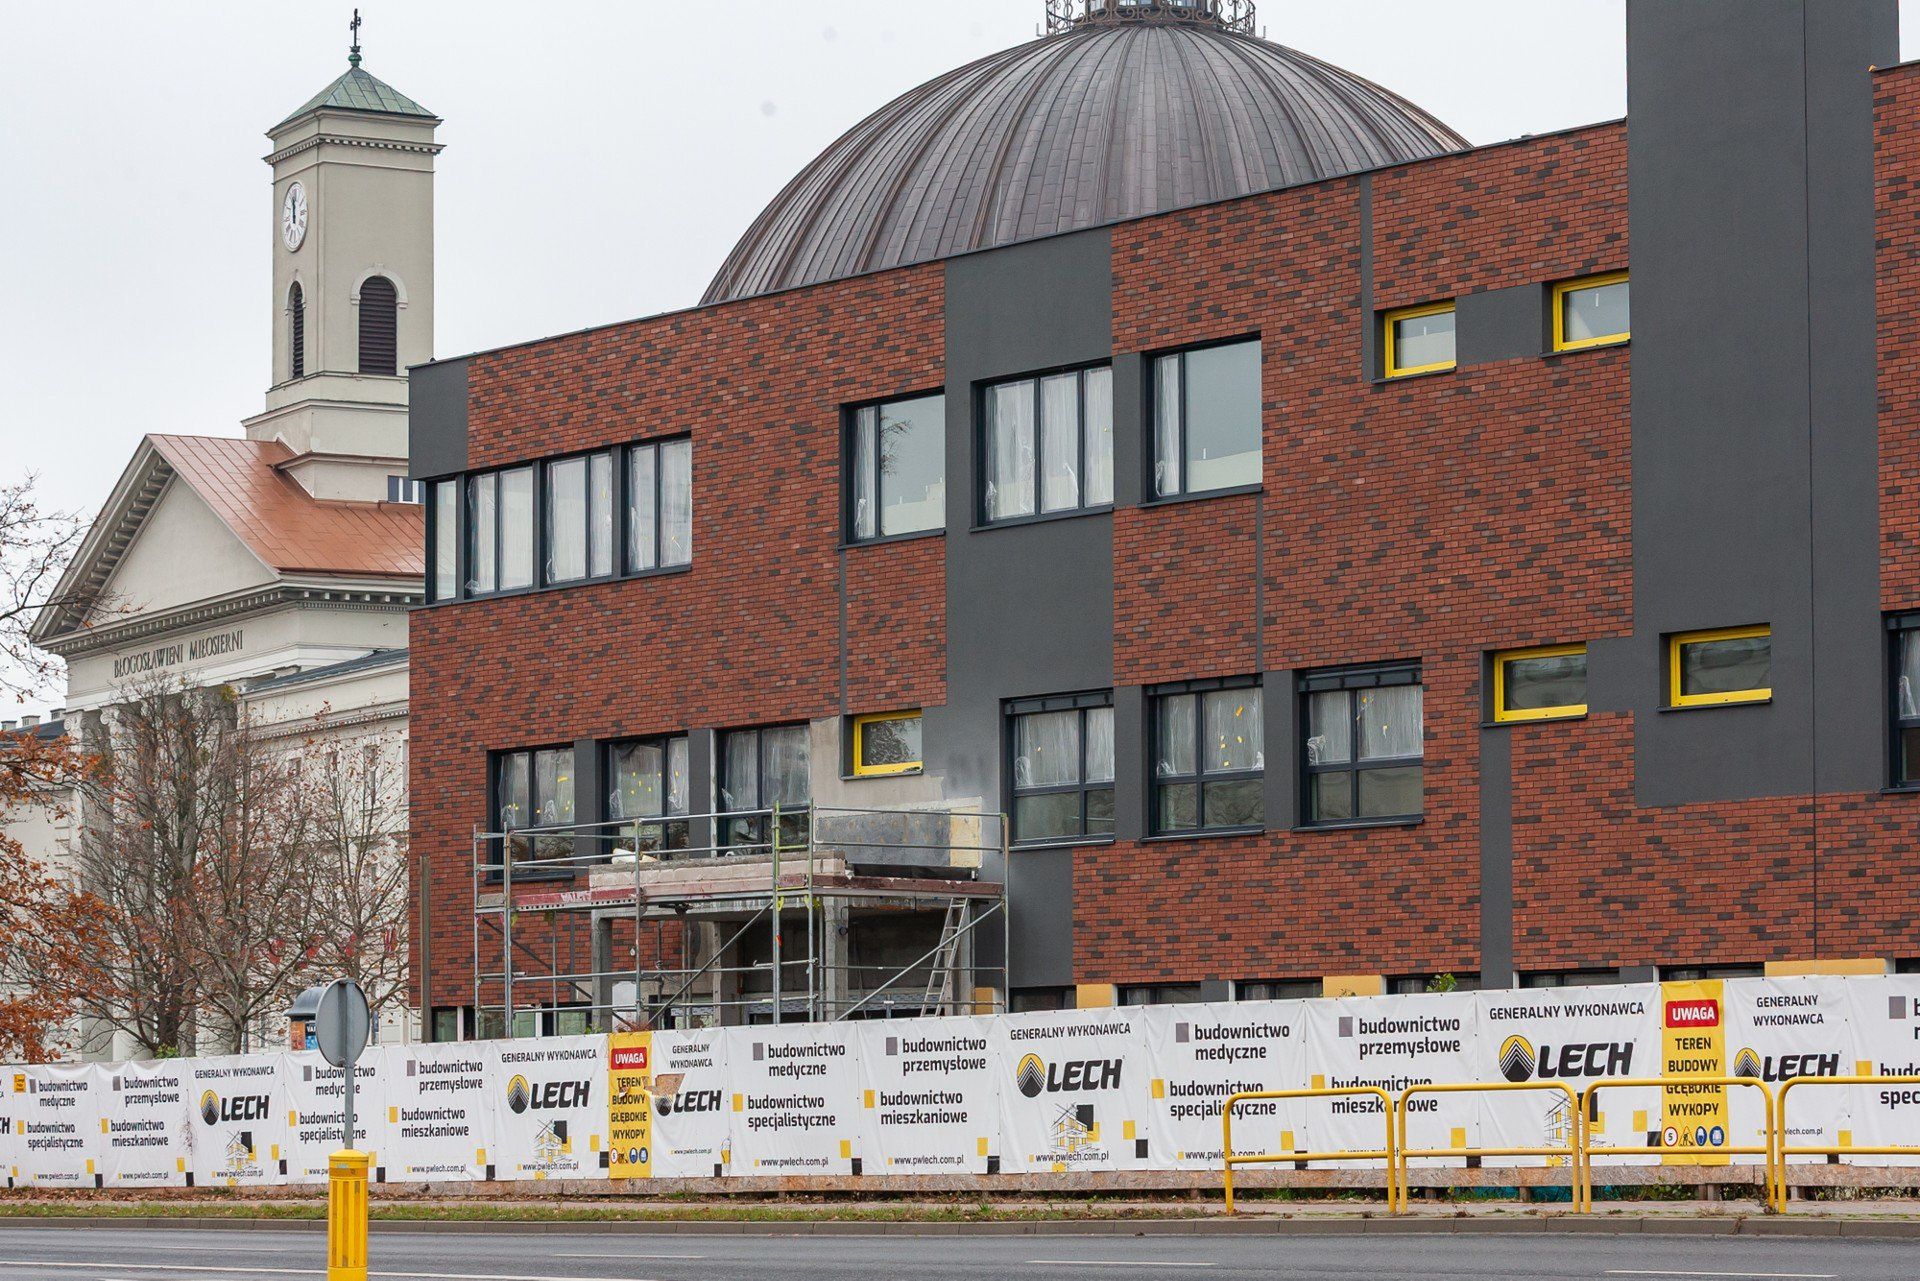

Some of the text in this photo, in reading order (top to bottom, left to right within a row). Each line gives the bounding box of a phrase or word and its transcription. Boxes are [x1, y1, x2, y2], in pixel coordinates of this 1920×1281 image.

[189, 630, 243, 661] MIŁOSIERNI
[1756, 994, 1819, 1008] GENERALNY
[1489, 1001, 1644, 1020] GENERALNY WYKONAWCA
[1672, 1006, 1715, 1021] UWAGA
[1359, 1015, 1460, 1035] budownictwo
[1753, 1013, 1824, 1027] WYKONAWCA
[1010, 1022, 1131, 1041] GENERALNY WYKONAWCA
[1194, 1022, 1290, 1041] budownictwo
[672, 1043, 710, 1054] GENERALNY
[768, 1042, 846, 1059] budownictwo
[902, 1036, 987, 1053] budownictwo
[1359, 1037, 1461, 1060] przemysłowe
[1675, 1037, 1712, 1050] TEREN
[501, 1048, 597, 1063] GENERALNY WYKONAWCA
[615, 1053, 645, 1064] UWAGA
[1195, 1044, 1267, 1064] medyczne
[1538, 1042, 1634, 1078] LECH
[419, 1059, 483, 1074] budownictwo
[669, 1058, 713, 1069] WYKONAWCA
[768, 1062, 827, 1080] medyczne
[902, 1055, 986, 1076] przemysłowe
[1668, 1058, 1718, 1072] BUDOWY
[1762, 1053, 1839, 1082] LECH
[195, 1065, 275, 1079] GENERALNY WYKONAWCA
[315, 1065, 376, 1079] budowctwo
[1046, 1058, 1123, 1093] LECH
[38, 1078, 88, 1093] budownictwo
[124, 1074, 179, 1090] budownictwo
[419, 1076, 483, 1095] przemysłowe
[617, 1077, 641, 1087] TEREN
[315, 1082, 361, 1099] medyce
[530, 1080, 590, 1110] LECH
[880, 1089, 963, 1106] budownictwo
[39, 1093, 76, 1110] medyczne
[125, 1091, 180, 1108] przemysłowe
[612, 1094, 645, 1105] BUDOWY
[674, 1089, 722, 1113] LECH
[748, 1094, 825, 1109] budownictwo
[221, 1095, 270, 1121] LECH
[401, 1106, 466, 1121] budownictwo
[1668, 1103, 1719, 1116] WYKOPY
[300, 1110, 358, 1124] budownicto
[611, 1111, 647, 1124] GŁĘBOKIE
[748, 1112, 836, 1131] specjalistyczne
[880, 1108, 968, 1125] mieszkaniowe
[27, 1119, 76, 1133] budownictwo
[110, 1118, 165, 1132] budownictwo
[401, 1123, 470, 1138] mieszkaniowe
[112, 1133, 169, 1147] mieszkaniowe
[612, 1129, 645, 1139] WYKOPY
[1668, 1132, 1673, 1141] 5
[27, 1136, 84, 1151] specjalistyczne
[761, 1157, 829, 1168] www.pwlech.com.pl
[894, 1154, 964, 1166] www.pwlech.com.pl
[1036, 1150, 1109, 1163] www.pwlech.com.pl
[216, 1167, 263, 1178] www.pwlech.com.pl
[412, 1164, 466, 1174] www.pwlech.com.pl
[522, 1161, 579, 1172] www.pwlech.com.pl
[38, 1173, 80, 1181] www.pwlech.com.pl
[122, 1172, 169, 1181] www.pwlech.com.pl
